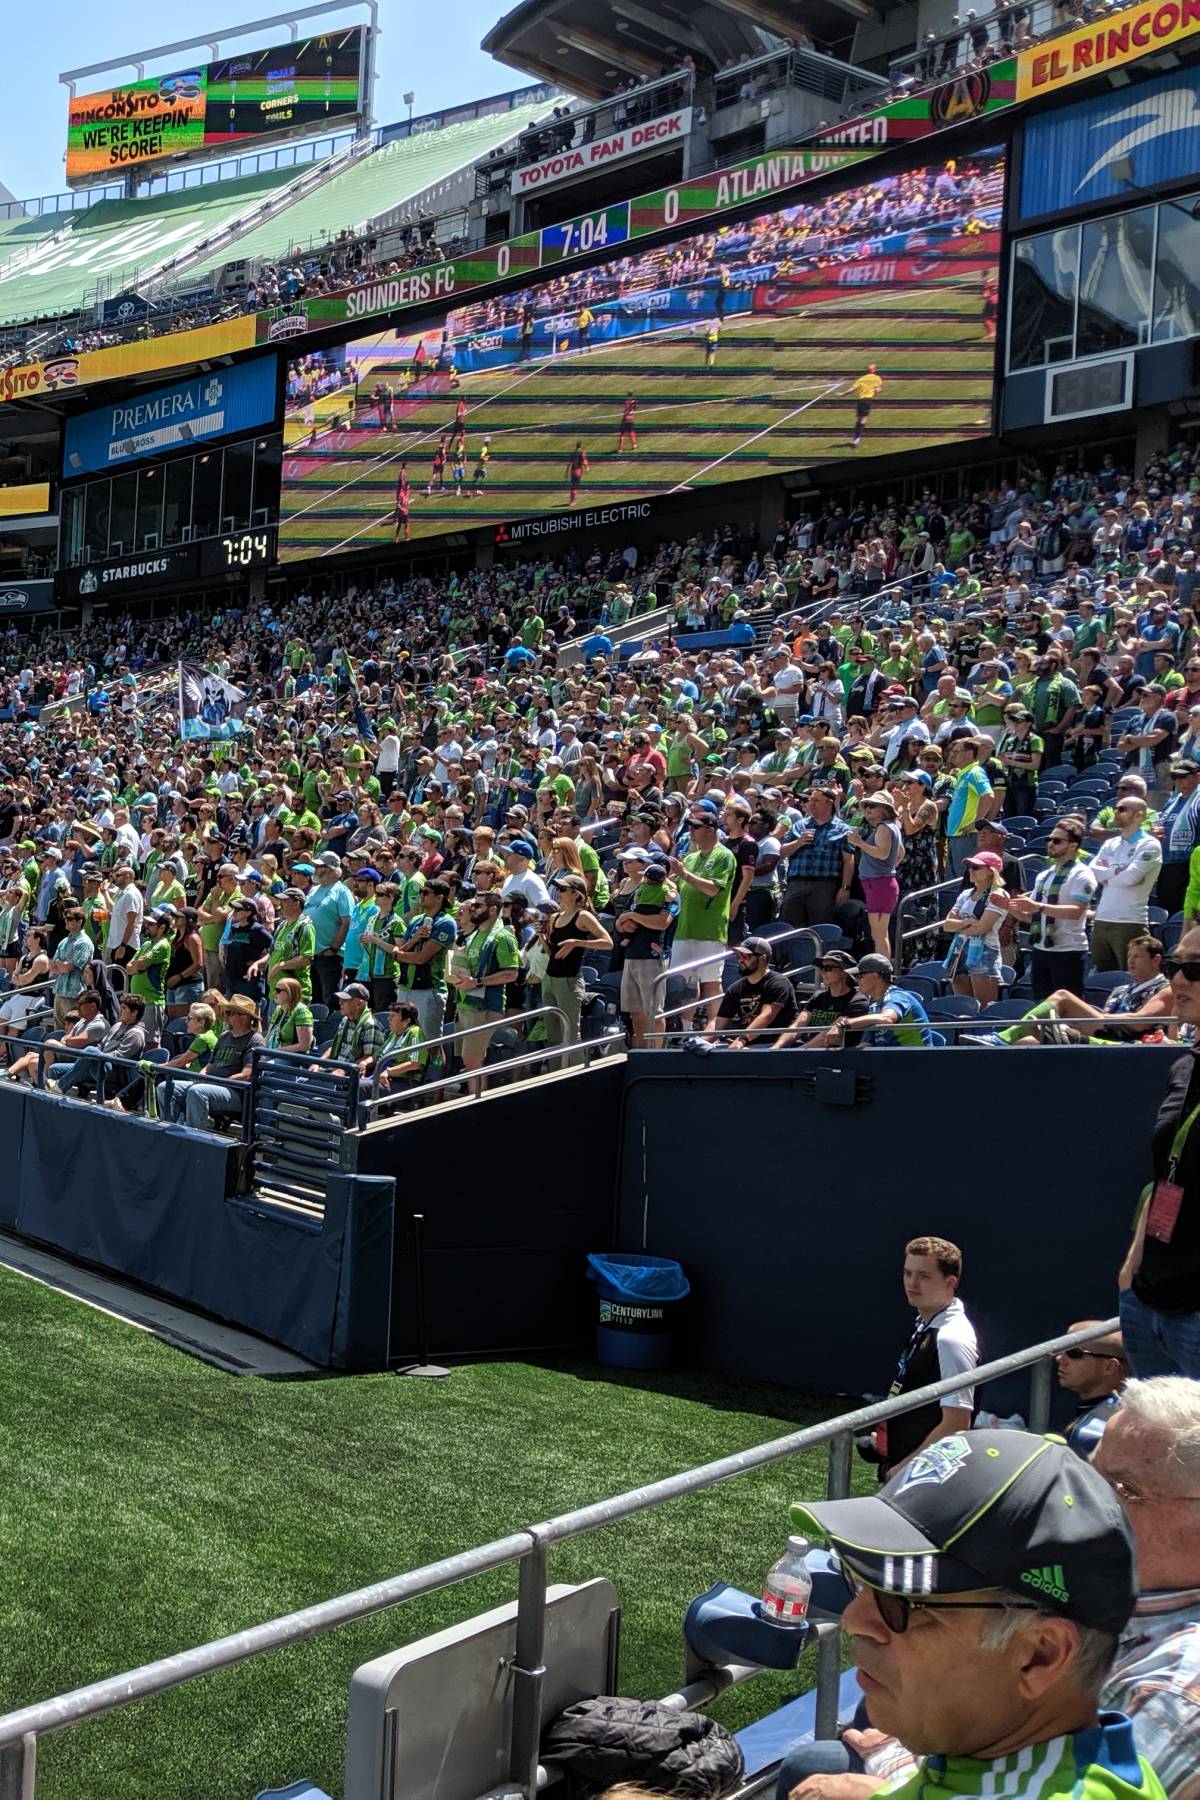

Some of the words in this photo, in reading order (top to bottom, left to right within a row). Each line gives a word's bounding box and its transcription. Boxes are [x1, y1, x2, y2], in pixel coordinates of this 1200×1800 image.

[1032, 50, 1069, 87] EL
[111, 91, 126, 103] EL
[260, 94, 299, 111] CORNERS
[83, 120, 130, 149] WE'RE
[132, 107, 193, 139] KEEPIN'
[109, 139, 162, 164] SCORE!
[519, 152, 584, 188] TOYOTA
[590, 136, 624, 161] FAN
[630, 115, 682, 147] DECK
[346, 271, 431, 318] SOUNDERS
[434, 266, 455, 294] FC
[497, 245, 510, 277] 0
[561, 213, 608, 257] 7:04
[664, 190, 679, 224] 0
[716, 152, 805, 208] ATLANTA
[111, 391, 194, 435] PREMERA
[111, 442, 127, 456] BLU
[511, 515, 582, 539] MITSUBISHI
[585, 503, 651, 526] ELECTRIC
[223, 534, 267, 565] 7:04
[102, 559, 168, 582] STARBUCKS
[1020, 1571, 1070, 1602] adidas
